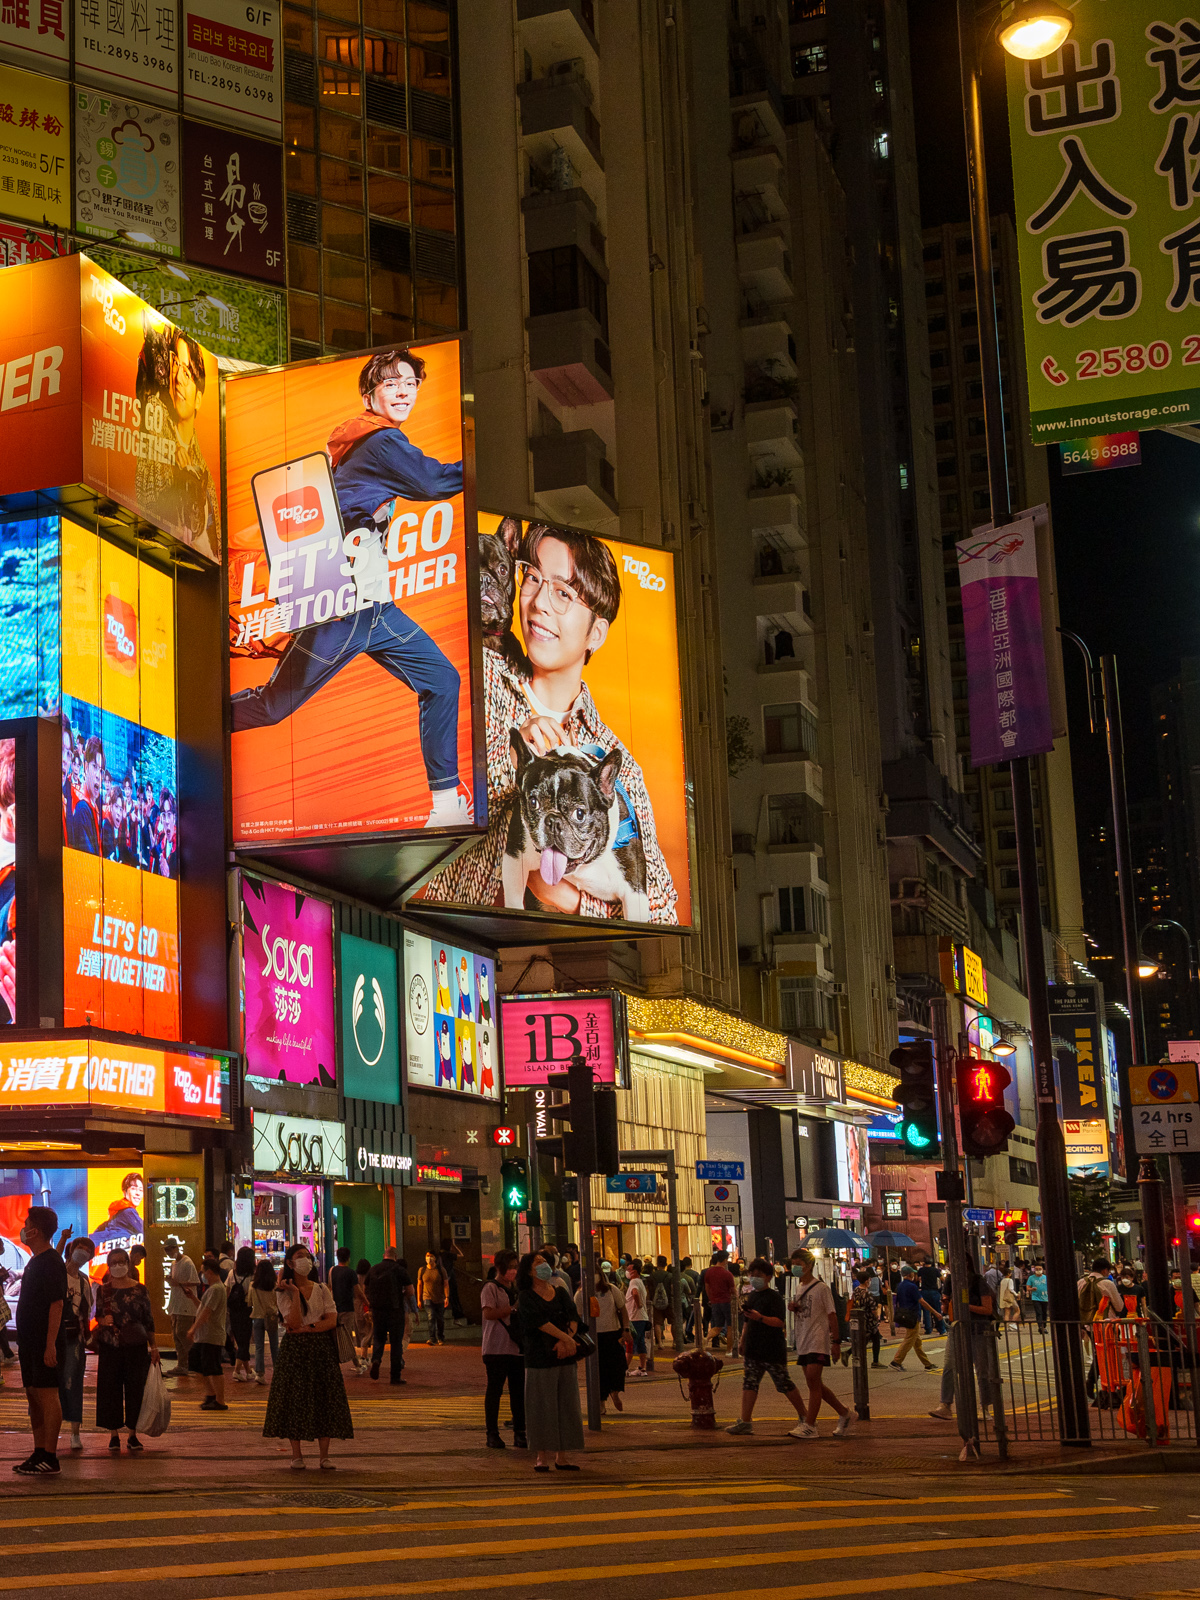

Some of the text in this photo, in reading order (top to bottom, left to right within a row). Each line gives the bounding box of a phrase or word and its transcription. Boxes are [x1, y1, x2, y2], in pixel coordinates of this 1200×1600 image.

[245, 6, 272, 27] 6/F
[83, 36, 174, 74] TEL:2895 3986
[191, 23, 269, 63] 금라보 한국요리
[187, 49, 274, 84] Jin Luo Bao Korean Restaurant
[188, 68, 274, 103] TEL:2895 6398
[77, 92, 111, 117] 5/F
[2, 153, 37, 170] 2333 9693
[13, 146, 37, 159] NOODLE
[39, 153, 66, 176] 5/F
[93, 202, 163, 228] Meet You Restaurant
[265, 249, 281, 268] 5F
[1075, 340, 1171, 381] 2580
[102, 389, 164, 434] LET'S GO
[1035, 401, 1191, 434] www.innoutstorage.com
[240, 502, 453, 609] LET'S GO
[988, 587, 1019, 749] 香港亞洲國際都會
[92, 913, 158, 958] LET'S GO
[274, 986, 302, 1026] 莎莎
[582, 1012, 601, 1061] 金百利
[523, 1064, 556, 1072] ISLAND
[814, 1053, 836, 1078] FASHION
[1074, 1027, 1097, 1107] IKEA
[824, 1076, 838, 1098] WALK
[1140, 1110, 1193, 1125] 24 hrs
[1147, 1129, 1189, 1148] 全日
[367, 1152, 413, 1171] THE BODY SHOP
[708, 1170, 732, 1178] 的士站
[712, 1214, 733, 1224] 全日
[722, 1205, 735, 1213] hrs
[99, 1233, 144, 1253] LET'S GO
